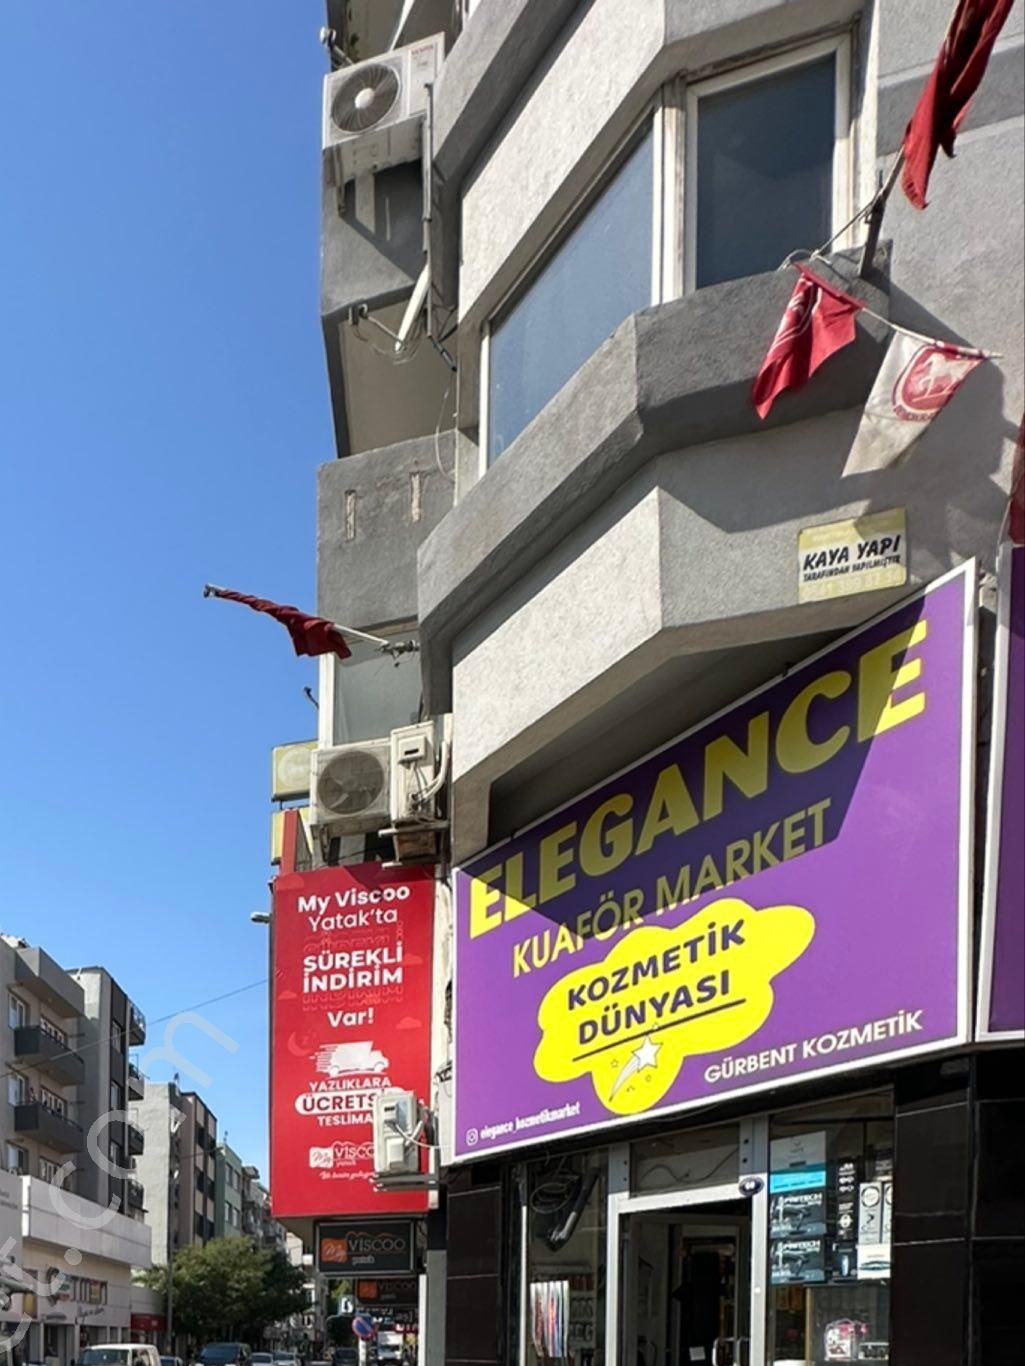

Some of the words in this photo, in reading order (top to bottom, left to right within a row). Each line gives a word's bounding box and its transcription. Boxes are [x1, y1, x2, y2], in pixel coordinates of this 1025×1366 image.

[803, 546, 849, 571] KAYA
[857, 534, 901, 560] YAPI
[470, 619, 928, 939] ELEGANCE
[298, 895, 330, 914] My
[335, 885, 410, 907] Viscoo
[512, 885, 645, 978] KUAFÖR
[656, 798, 832, 915] MARKET
[308, 909, 398, 932] Yatak'ta
[304, 941, 403, 973] SÜREKLİ
[566, 918, 747, 1011] KOZMETİK
[303, 966, 403, 993] İNDİRİM
[327, 1007, 374, 1027] Var!
[578, 969, 731, 1045] DÜNYASI
[703, 1042, 797, 1084] GÜRBENT
[803, 1008, 924, 1059] KOZMETİK
[303, 1092, 375, 1112] ÜCRETS
[317, 1111, 374, 1127] TESLİMA
